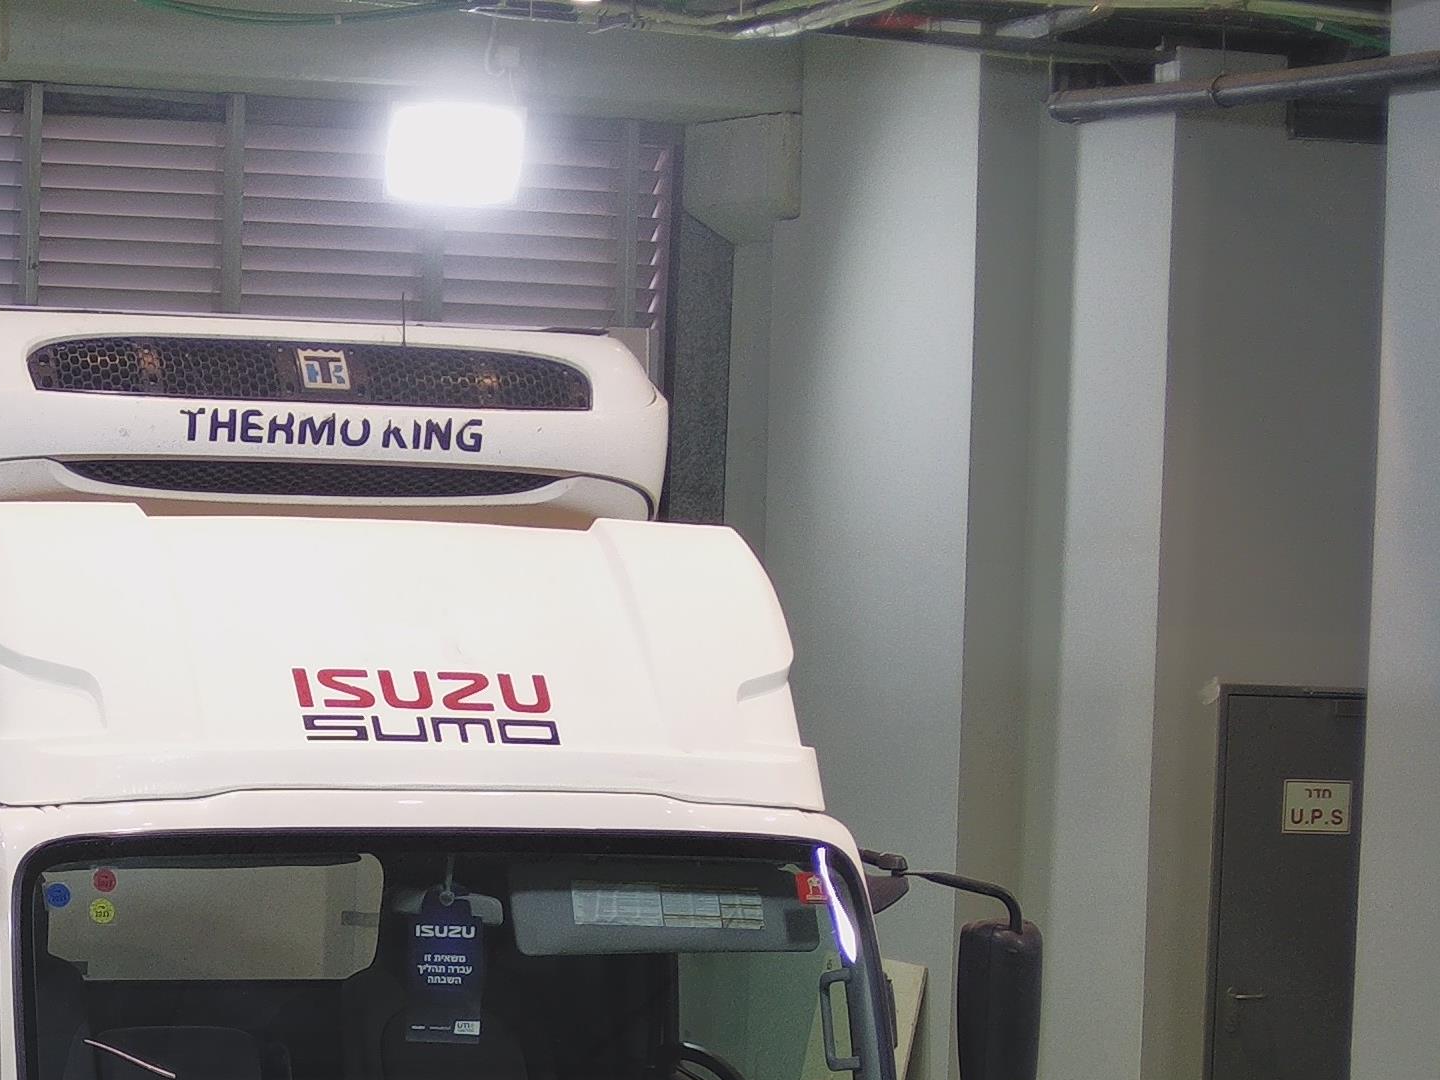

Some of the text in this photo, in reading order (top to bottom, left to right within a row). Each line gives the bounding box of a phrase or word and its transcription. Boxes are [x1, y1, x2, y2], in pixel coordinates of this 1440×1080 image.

[382, 417, 483, 453] KING
[291, 667, 552, 713] ISUZU
[302, 714, 561, 745] SUMO
[1304, 788, 1332, 799] חדר
[415, 924, 476, 938] ISUZU
[424, 953, 467, 963] משאית זו
[417, 963, 473, 975] עברה תהליך
